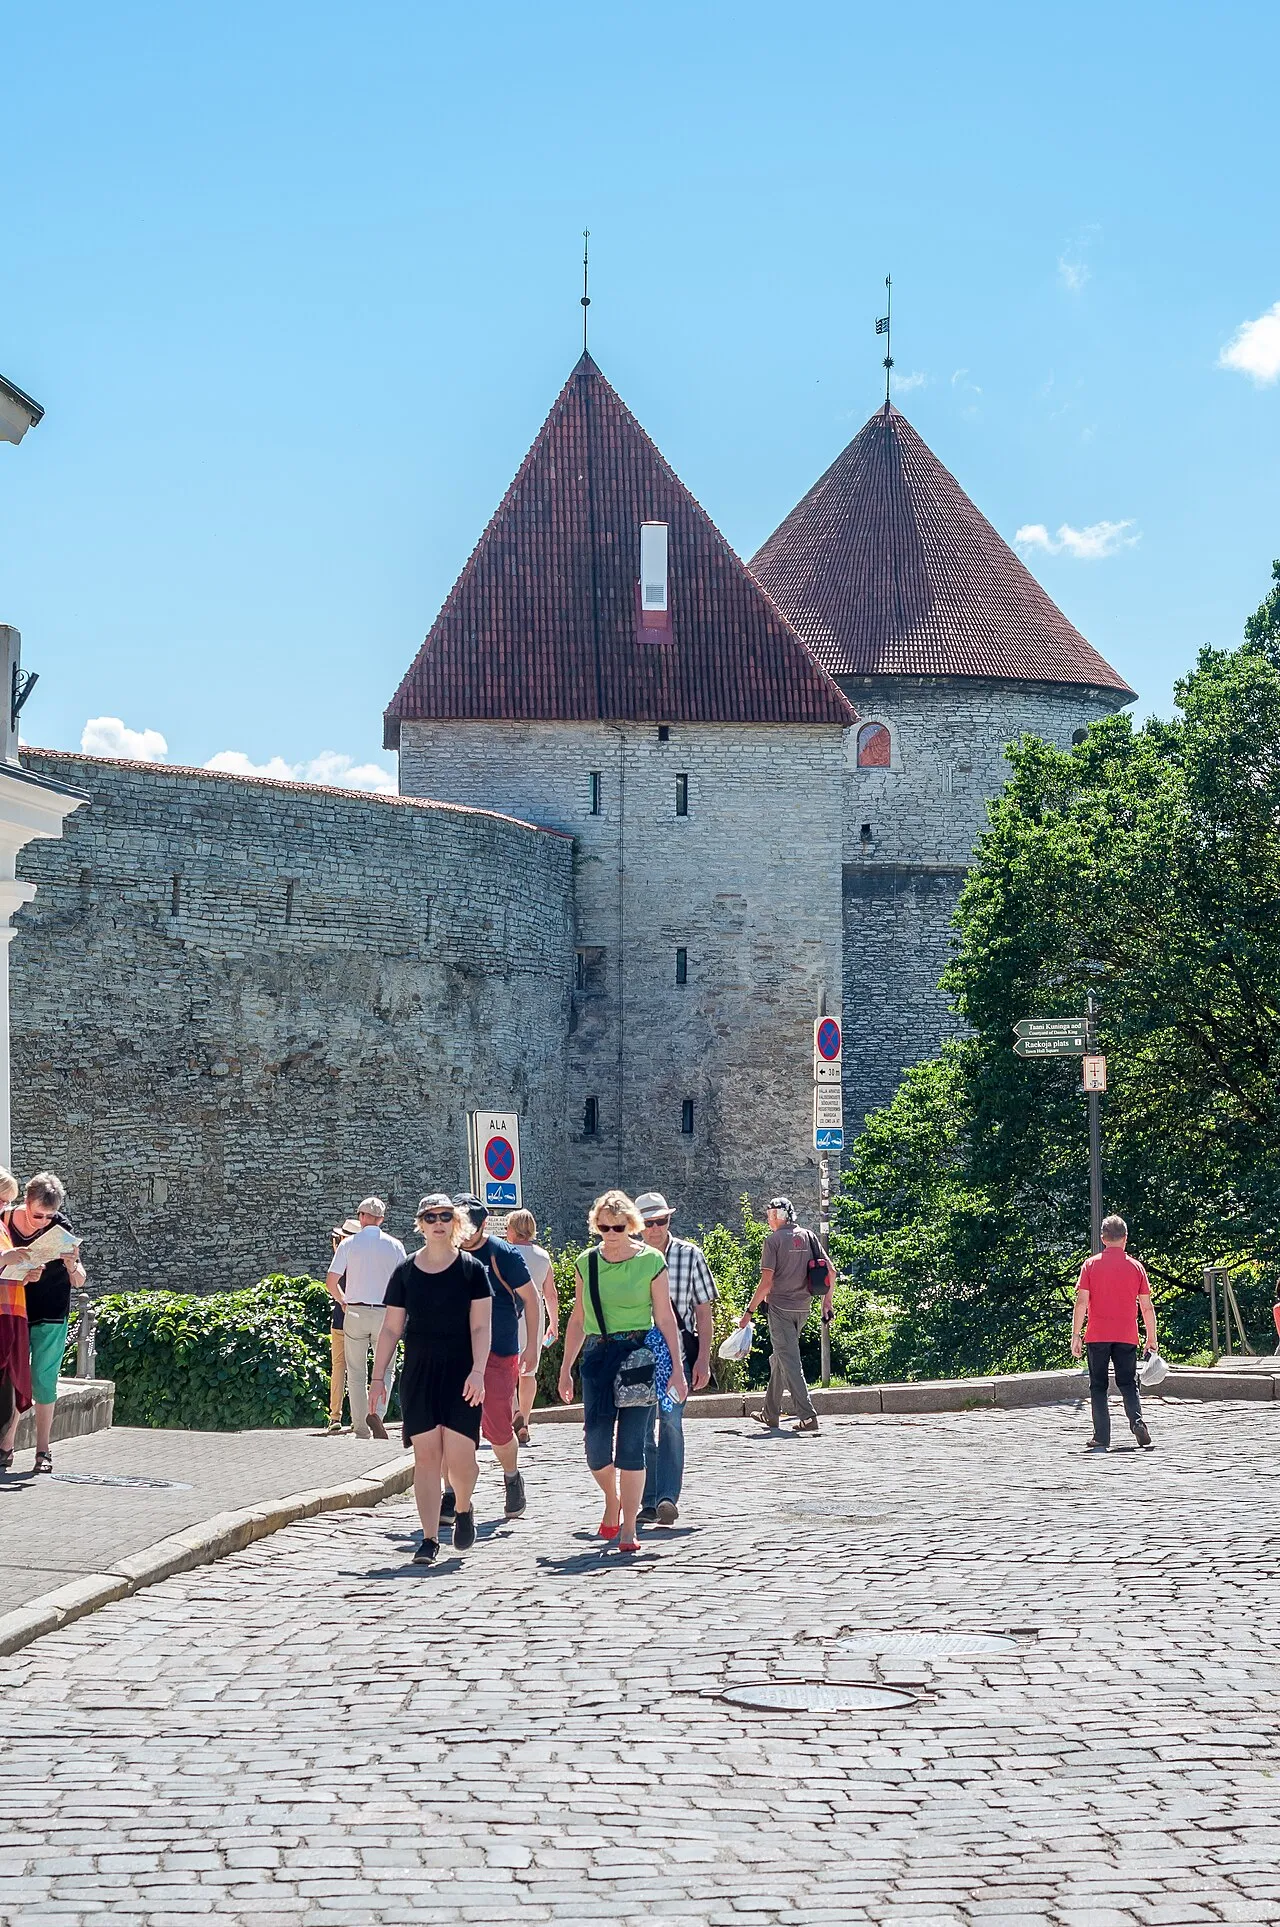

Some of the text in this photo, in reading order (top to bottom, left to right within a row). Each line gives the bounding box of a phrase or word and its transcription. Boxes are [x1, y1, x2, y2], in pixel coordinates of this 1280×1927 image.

[1046, 1023, 1070, 1031] Kuninga
[1053, 1040, 1070, 1048] plats
[828, 1068, 834, 1076] 30
[490, 1120, 507, 1130] ALA
